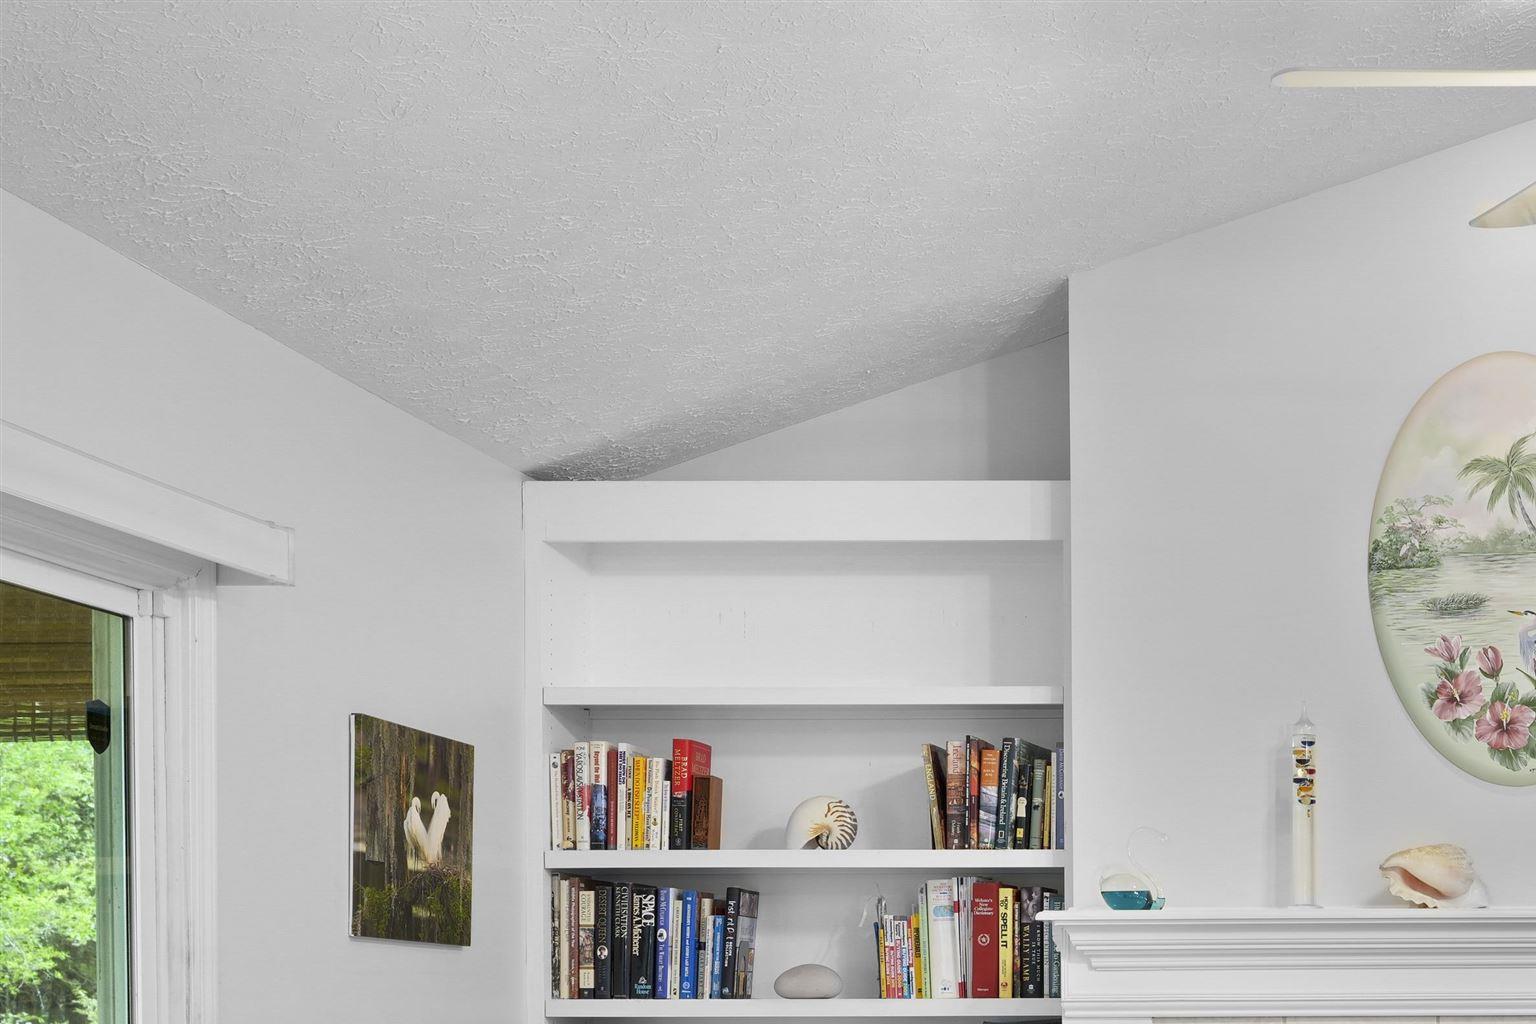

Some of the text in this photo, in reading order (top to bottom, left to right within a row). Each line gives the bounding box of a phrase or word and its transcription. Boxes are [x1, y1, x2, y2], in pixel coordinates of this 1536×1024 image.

[952, 745, 962, 774] Ireland
[1002, 744, 1010, 778] Discovering
[925, 764, 935, 801] ENGLAND
[576, 794, 584, 820] STATION
[620, 886, 628, 938] CIVILISATION
[633, 894, 642, 916] James
[642, 894, 656, 927] SPACE
[597, 916, 606, 944] QUEEN
[632, 924, 642, 956] Michener
[1000, 912, 1008, 948] SPELL IT
[1022, 924, 1030, 982] WALLY LAMB
[1052, 960, 1060, 994] Gardening
